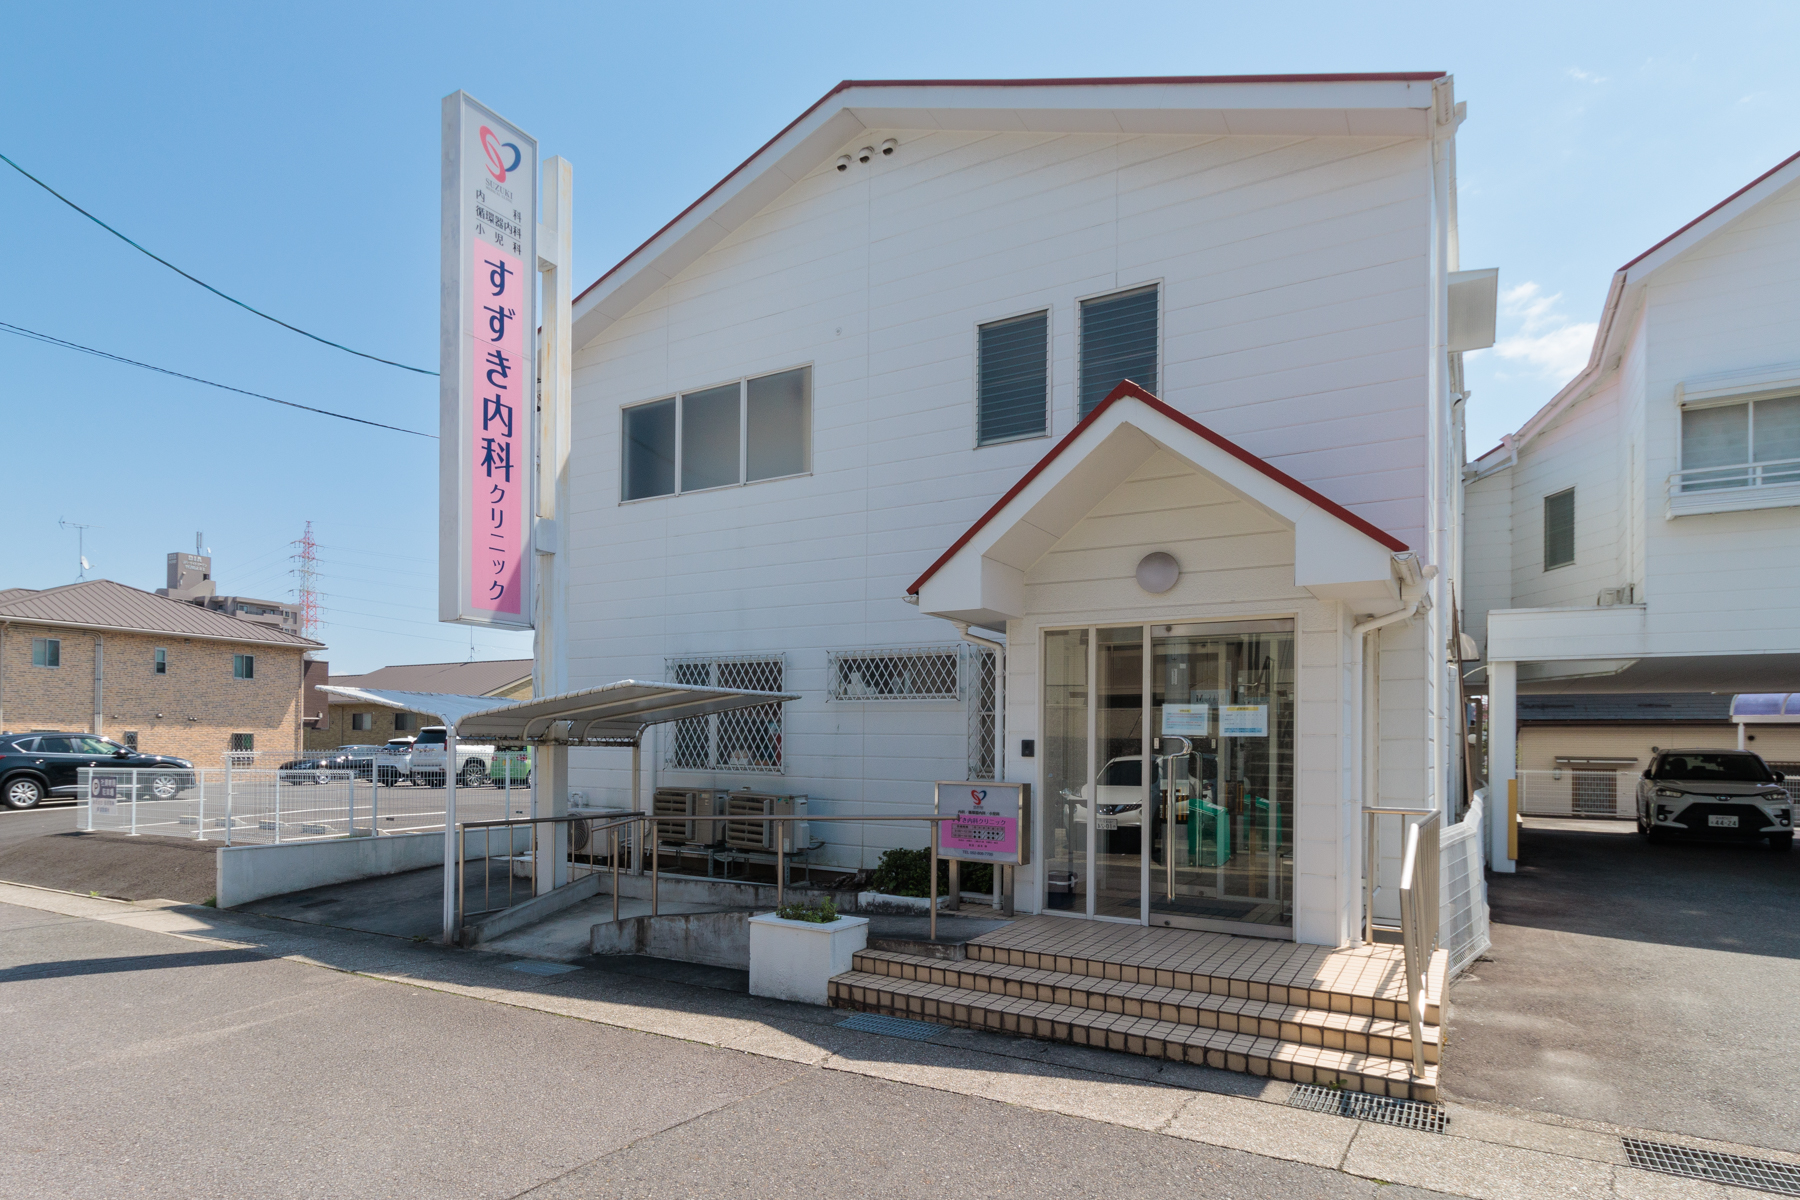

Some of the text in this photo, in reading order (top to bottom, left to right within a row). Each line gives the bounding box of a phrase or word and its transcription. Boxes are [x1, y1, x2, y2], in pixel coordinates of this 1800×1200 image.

[485, 178, 513, 200] SUZUKI
[476, 205, 522, 239] 循環器内科
[481, 259, 516, 601] すずき内科クリニック
[952, 817, 1006, 826] き内科クリニック
